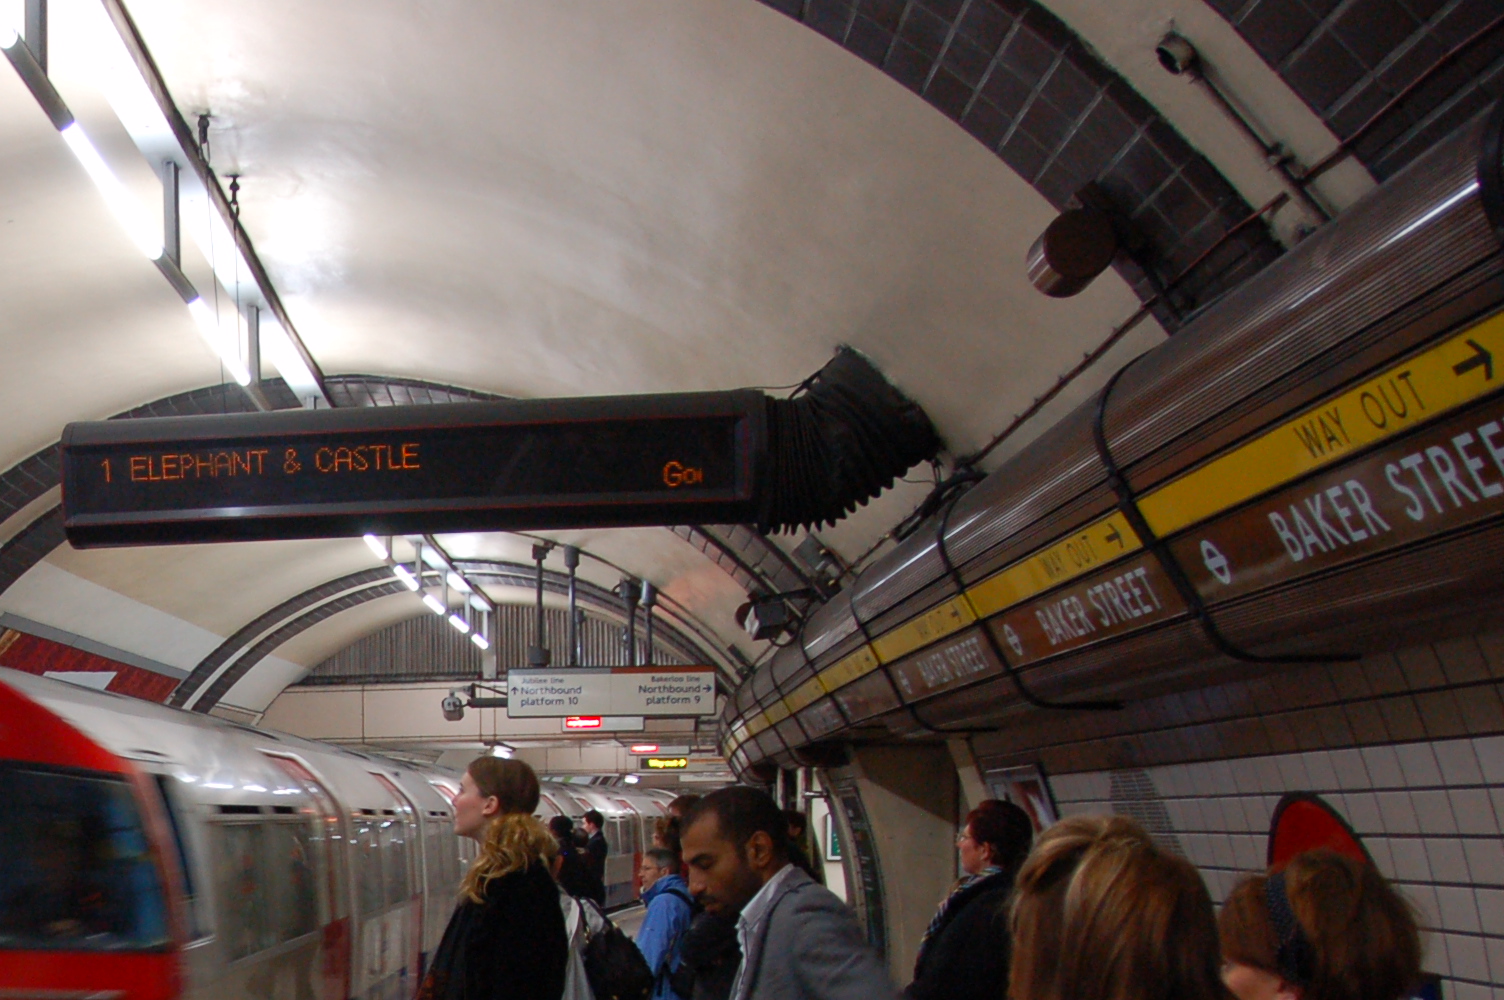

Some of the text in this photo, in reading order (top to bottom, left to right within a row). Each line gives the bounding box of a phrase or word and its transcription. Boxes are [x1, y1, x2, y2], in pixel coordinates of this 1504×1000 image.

[1293, 370, 1426, 459] WAY OUT
[100, 443, 421, 484] 1 ELEPHANT & CASTLE
[1268, 415, 1504, 563] BAKER STREE
[1039, 534, 1098, 580] WAY OUT
[1034, 566, 1163, 646] BAKER STREET
[522, 677, 565, 685] Jubilee line
[651, 675, 701, 683] Bakerloo line
[520, 686, 582, 696] Northbound
[638, 684, 701, 695] Northbound
[520, 696, 579, 707] platform 10
[646, 695, 701, 706] platform 9
